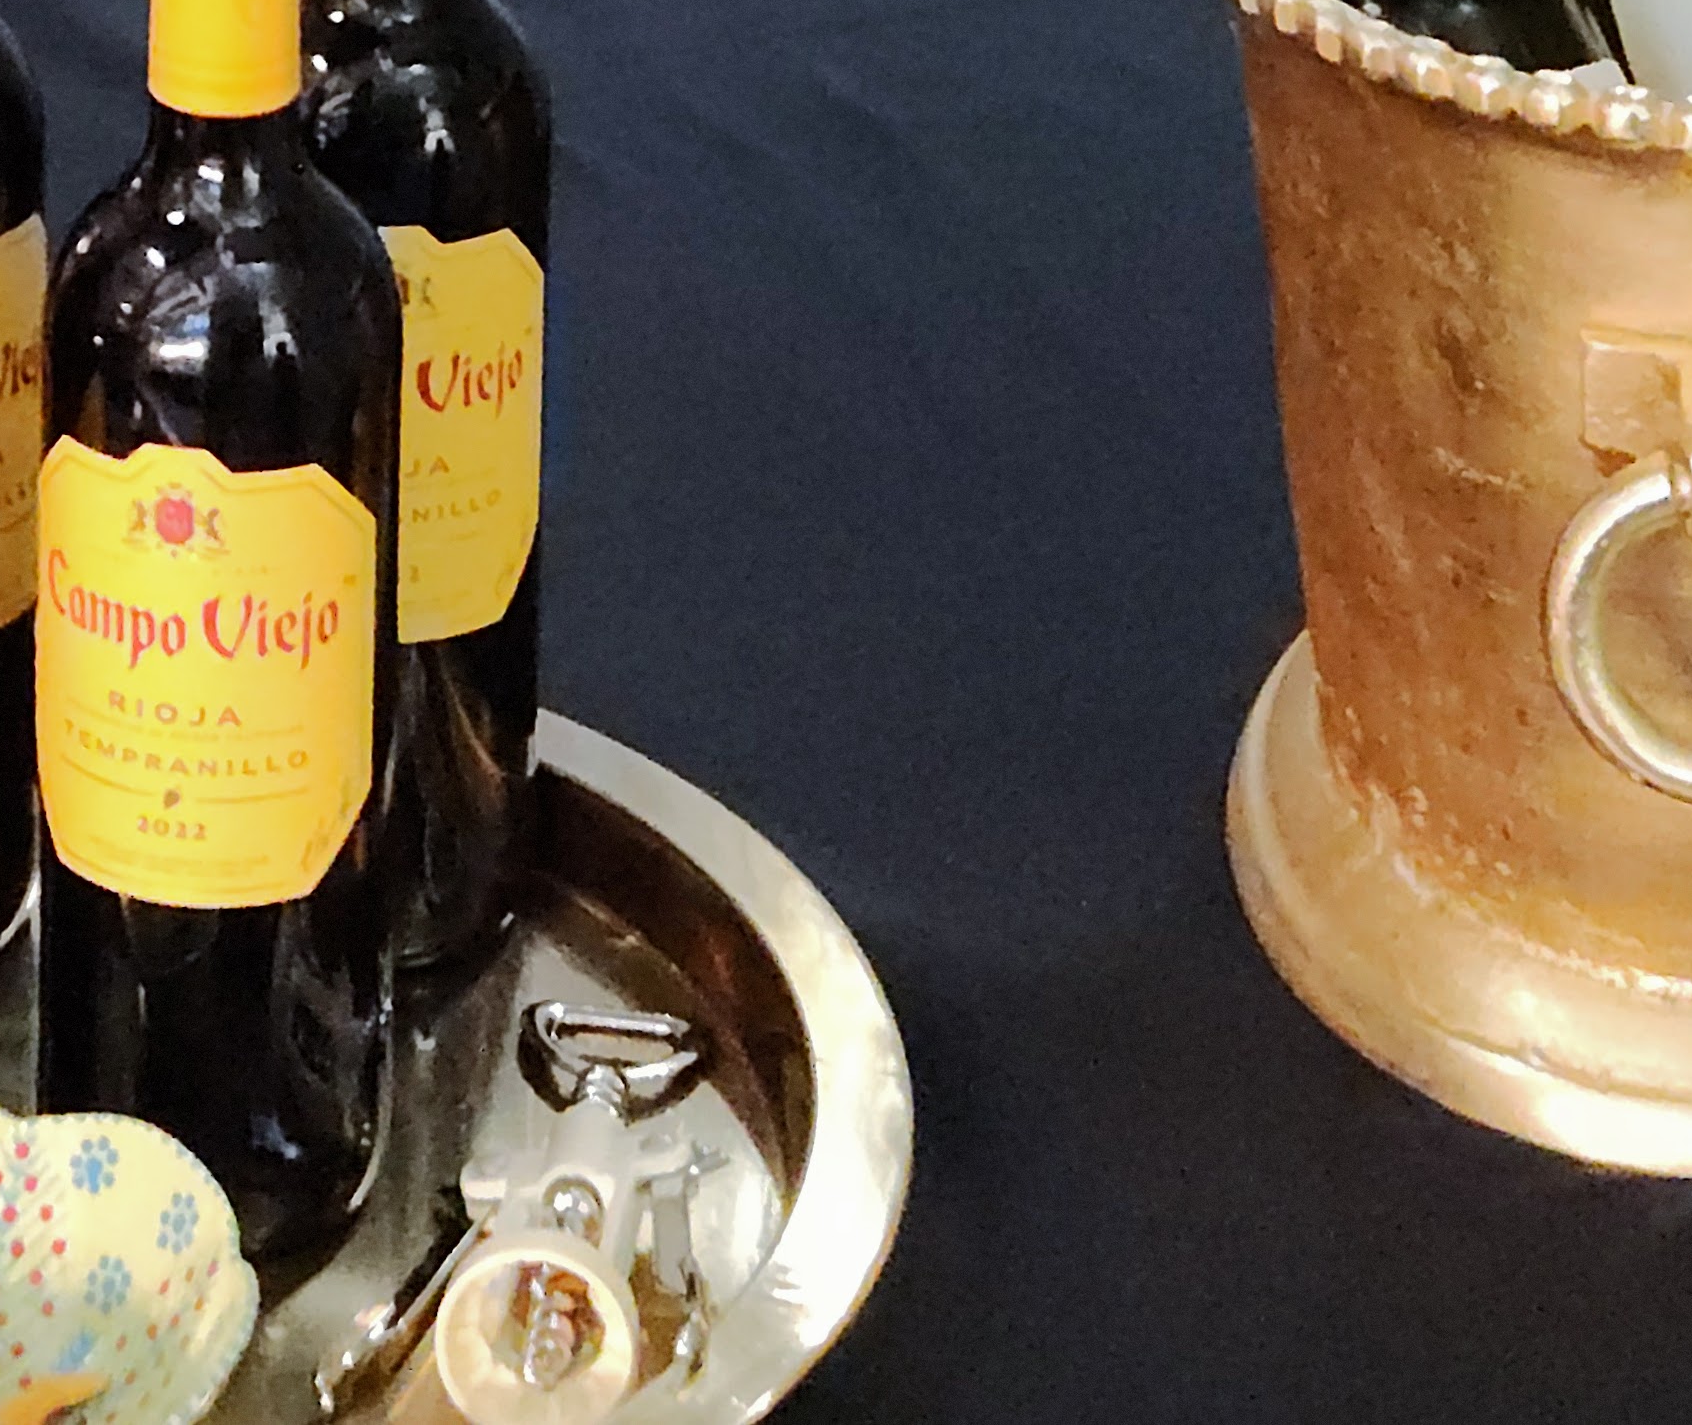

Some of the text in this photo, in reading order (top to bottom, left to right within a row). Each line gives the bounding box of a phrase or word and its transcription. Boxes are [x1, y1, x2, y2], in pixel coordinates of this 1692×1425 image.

[417, 340, 524, 420] Viejo
[47, 548, 340, 671] Campo Viejo
[108, 689, 243, 728] RIOJA
[64, 718, 309, 778] TEMPRANILLO
[137, 815, 207, 841] 2022
